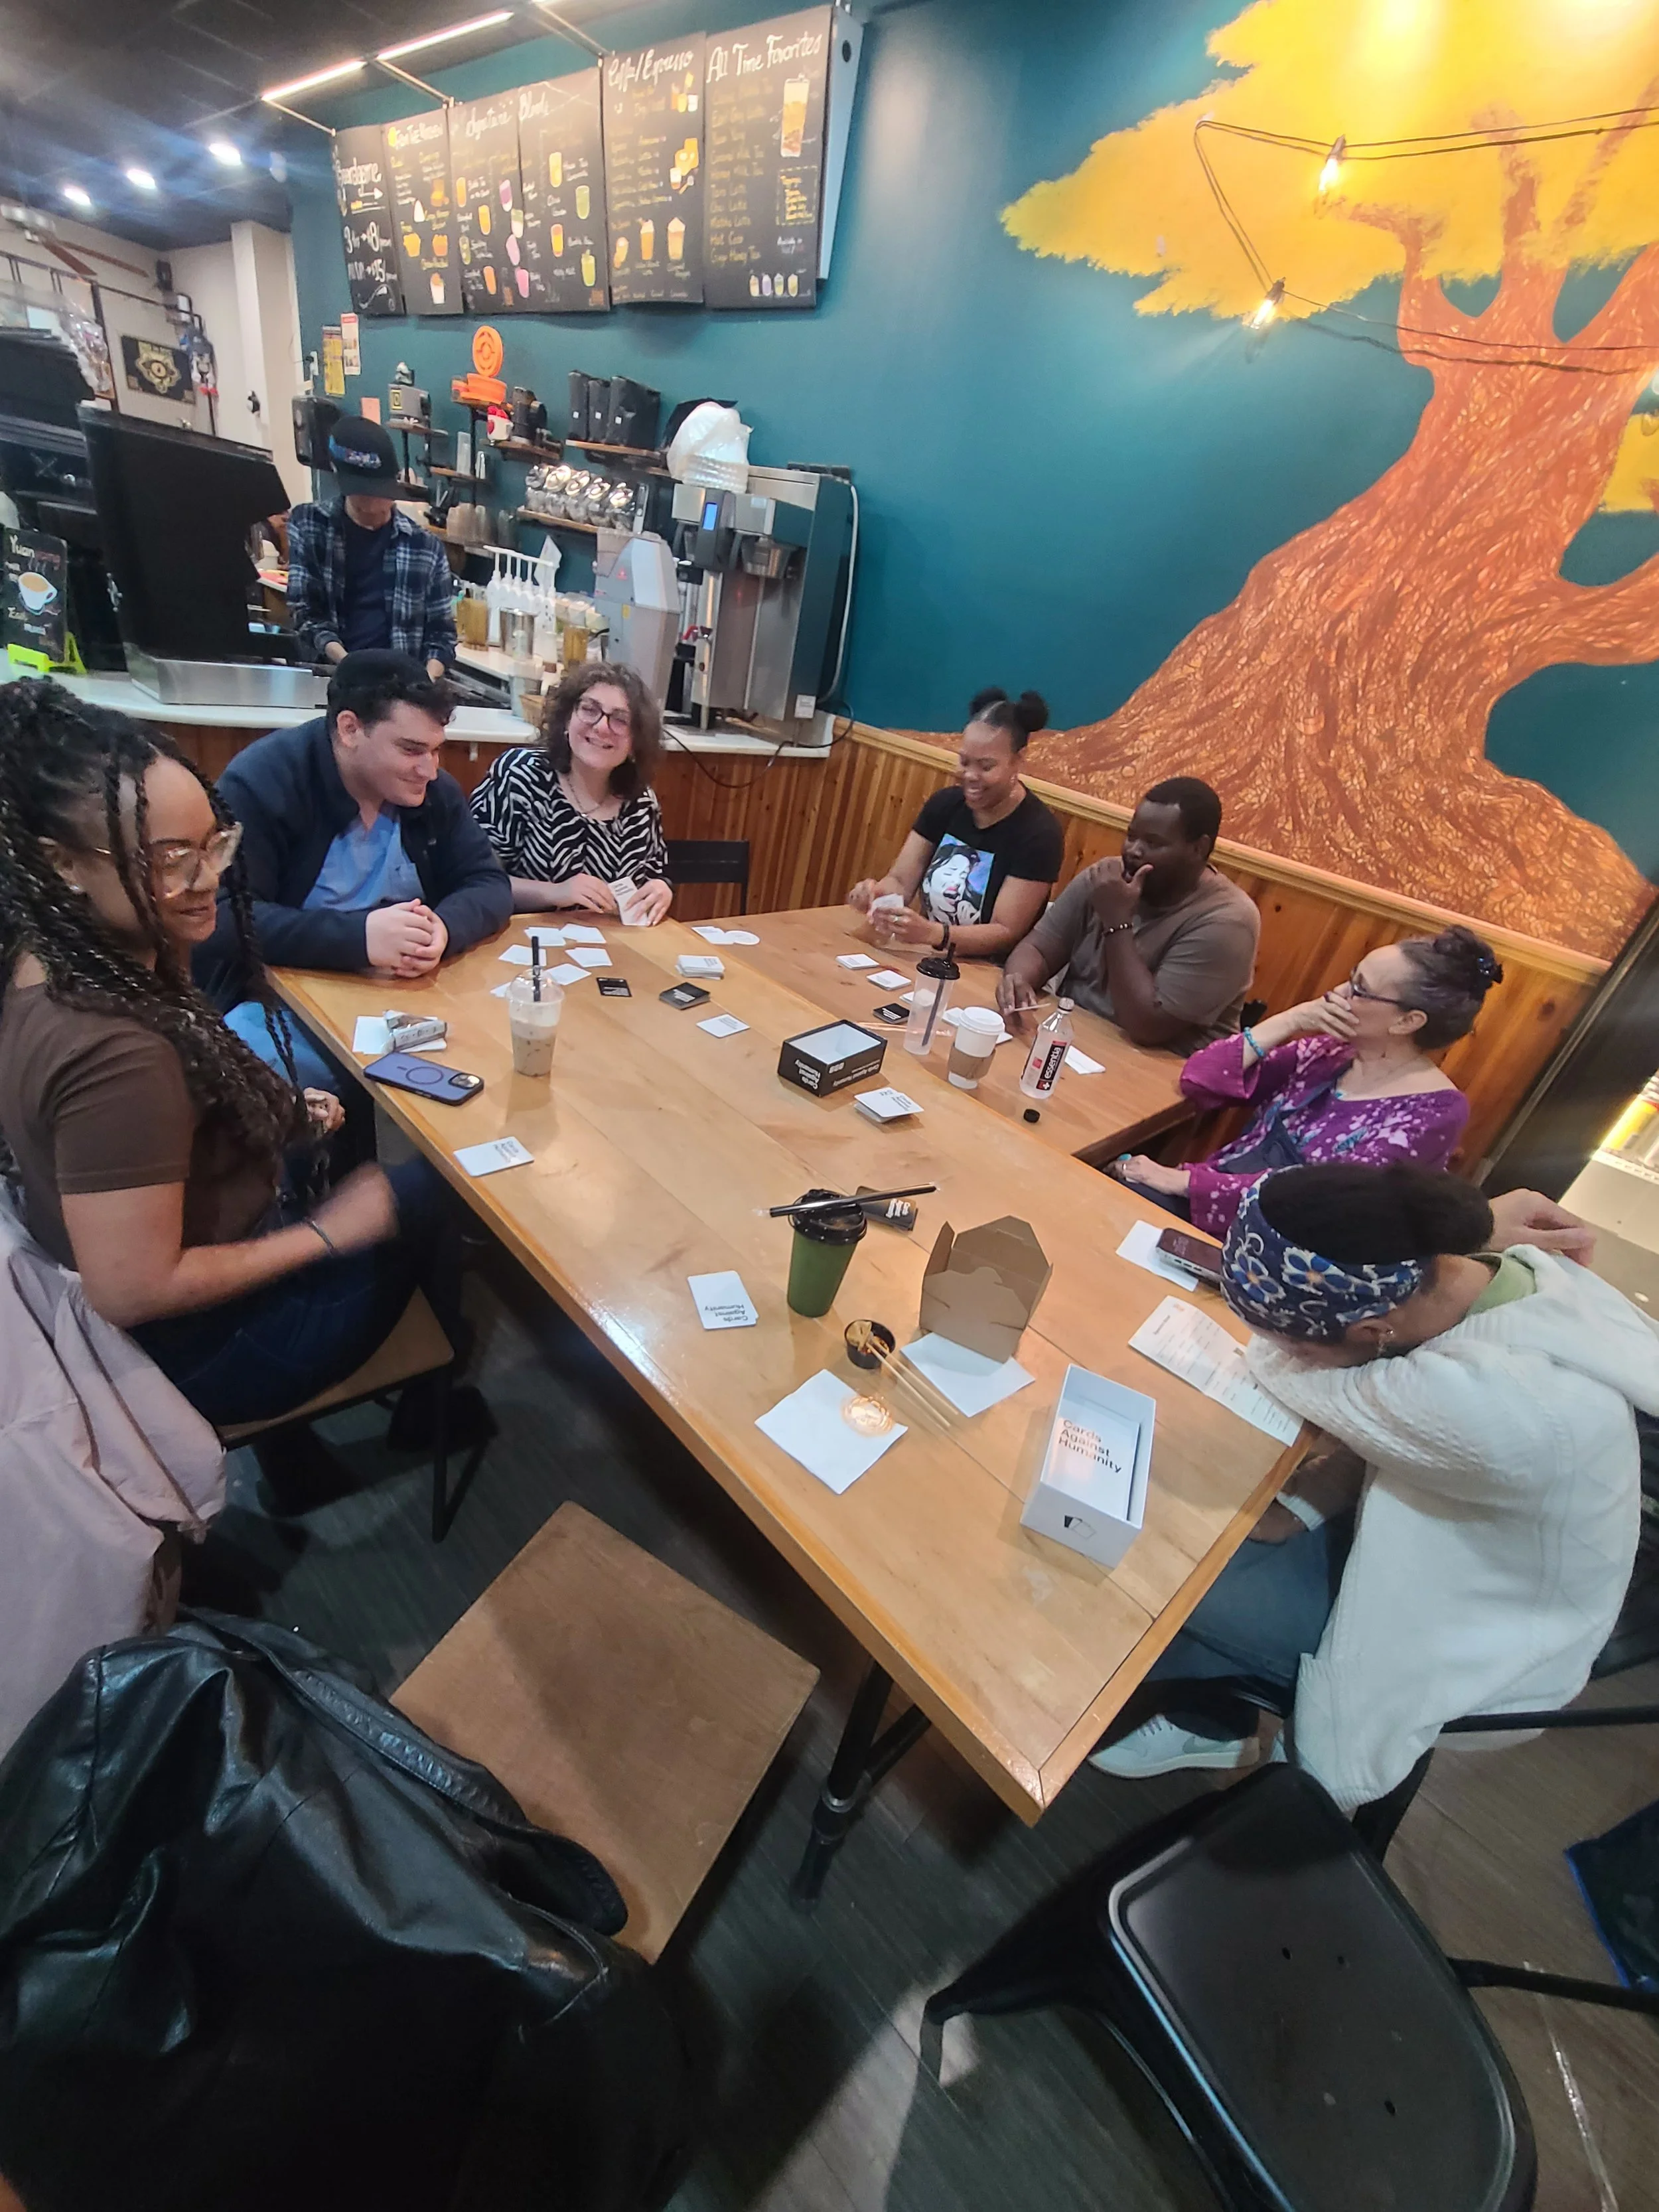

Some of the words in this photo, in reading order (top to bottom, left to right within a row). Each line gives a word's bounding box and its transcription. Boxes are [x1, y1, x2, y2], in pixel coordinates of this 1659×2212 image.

[706, 46, 729, 84] All
[732, 43, 764, 76] Time
[766, 31, 822, 68] Favorites
[1045, 1047, 1062, 1079] essentia
[1061, 1429, 1110, 1457] Against
[1063, 1420, 1102, 1443] Cards
[1058, 1436, 1121, 1473] Humanity
